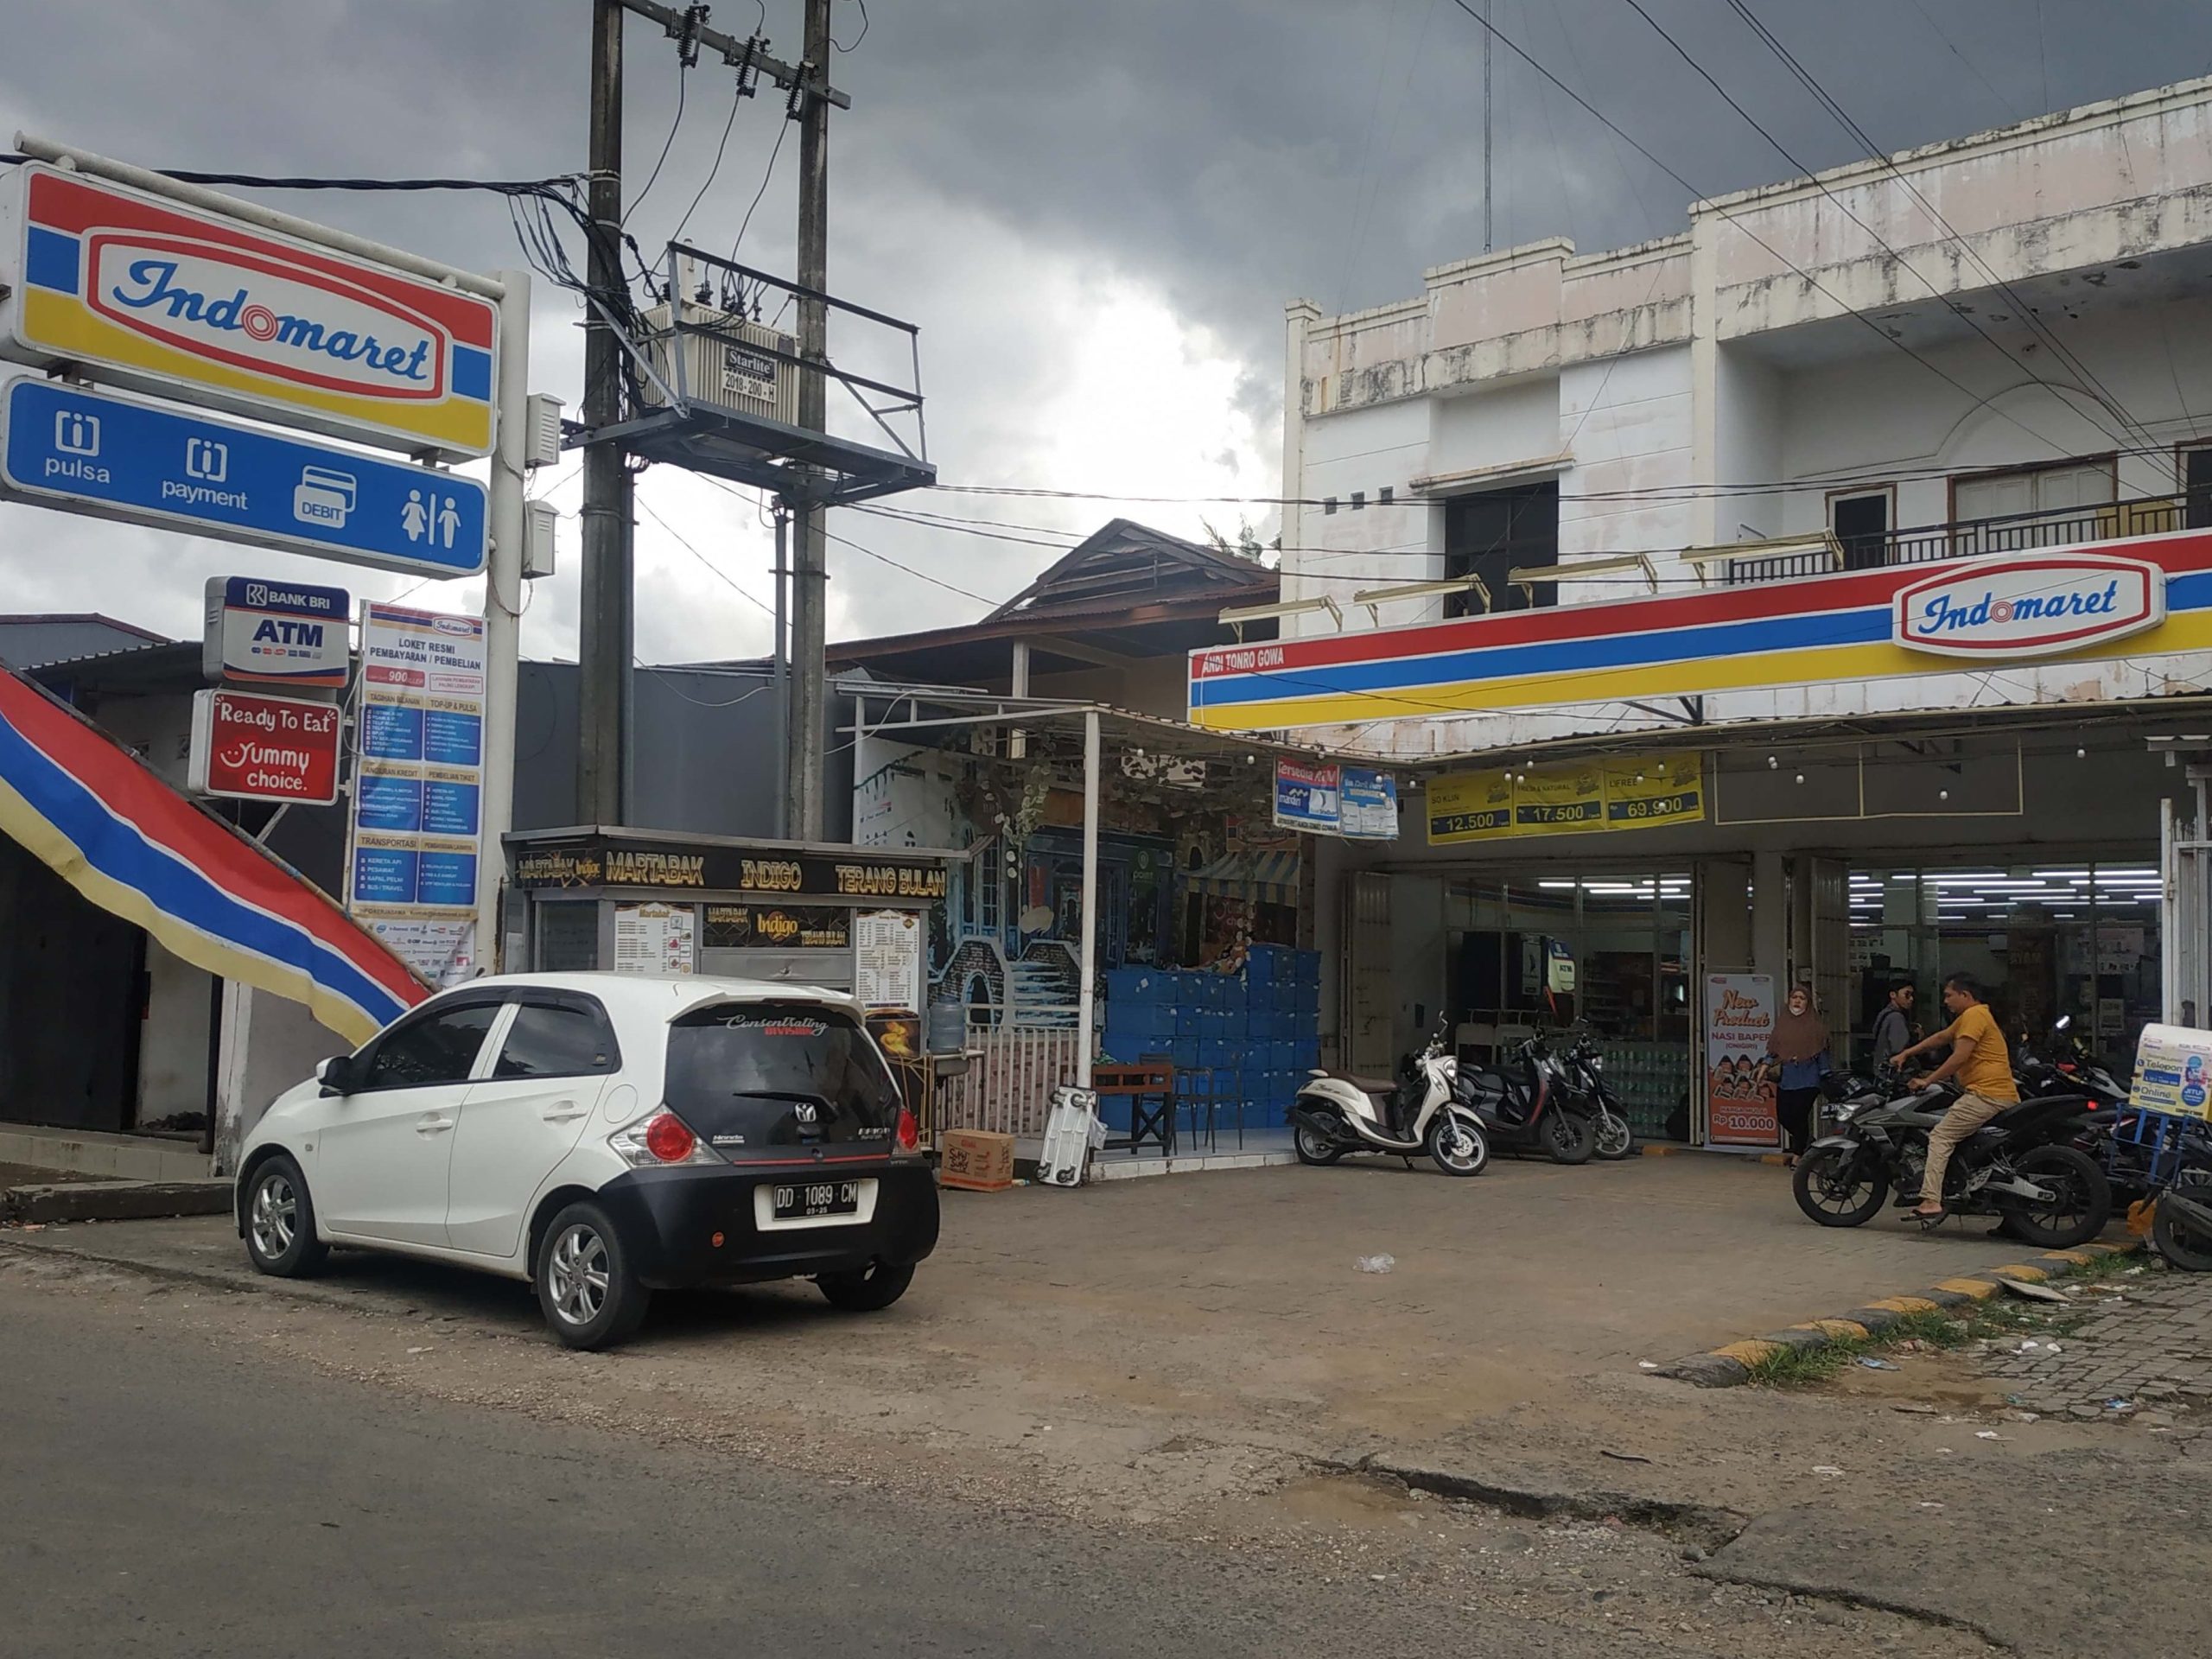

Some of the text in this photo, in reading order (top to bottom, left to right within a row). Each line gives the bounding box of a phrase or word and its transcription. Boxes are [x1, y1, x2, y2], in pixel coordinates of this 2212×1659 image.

[112, 259, 430, 380] Indomaret
[729, 350, 771, 374] Starlite
[45, 457, 111, 485] pulsa
[162, 479, 249, 511] payment
[302, 500, 343, 522] DEBIT
[269, 591, 330, 609] BANK BRI
[1917, 580, 2118, 633] Indomaret
[252, 619, 323, 647] ATM
[398, 638, 455, 655] LOKET RESMI
[370, 647, 427, 663] PEMBAYARAN
[434, 656, 481, 671] PEMBELIAN
[1203, 647, 1284, 672] ANDI TONRO GOWA
[389, 671, 408, 683] 900
[221, 702, 330, 733] Ready To Eat
[459, 702, 477, 713] PULSA
[220, 741, 309, 775] Yummy
[1533, 805, 1583, 821] 17.500
[1628, 797, 1682, 817] 69.900
[1446, 813, 1494, 831] 12.500
[361, 836, 416, 848] TRANSPORTASI
[518, 858, 575, 879] MARTABAK
[607, 851, 947, 897] MARTABAK INDIGO TERANG BULAN
[708, 907, 748, 923] MARTABAK
[757, 912, 798, 939] Indigo
[825, 931, 846, 945] BULAN
[1723, 989, 1759, 1009] New
[1713, 1008, 1770, 1027] Product
[1712, 1032, 1735, 1040] NASI
[2146, 1058, 2183, 1071] Telepon
[2141, 1086, 2171, 1098] Online
[1713, 1115, 1775, 1130] Rp 10.000
[777, 1182, 857, 1209] DD 1089 CM
